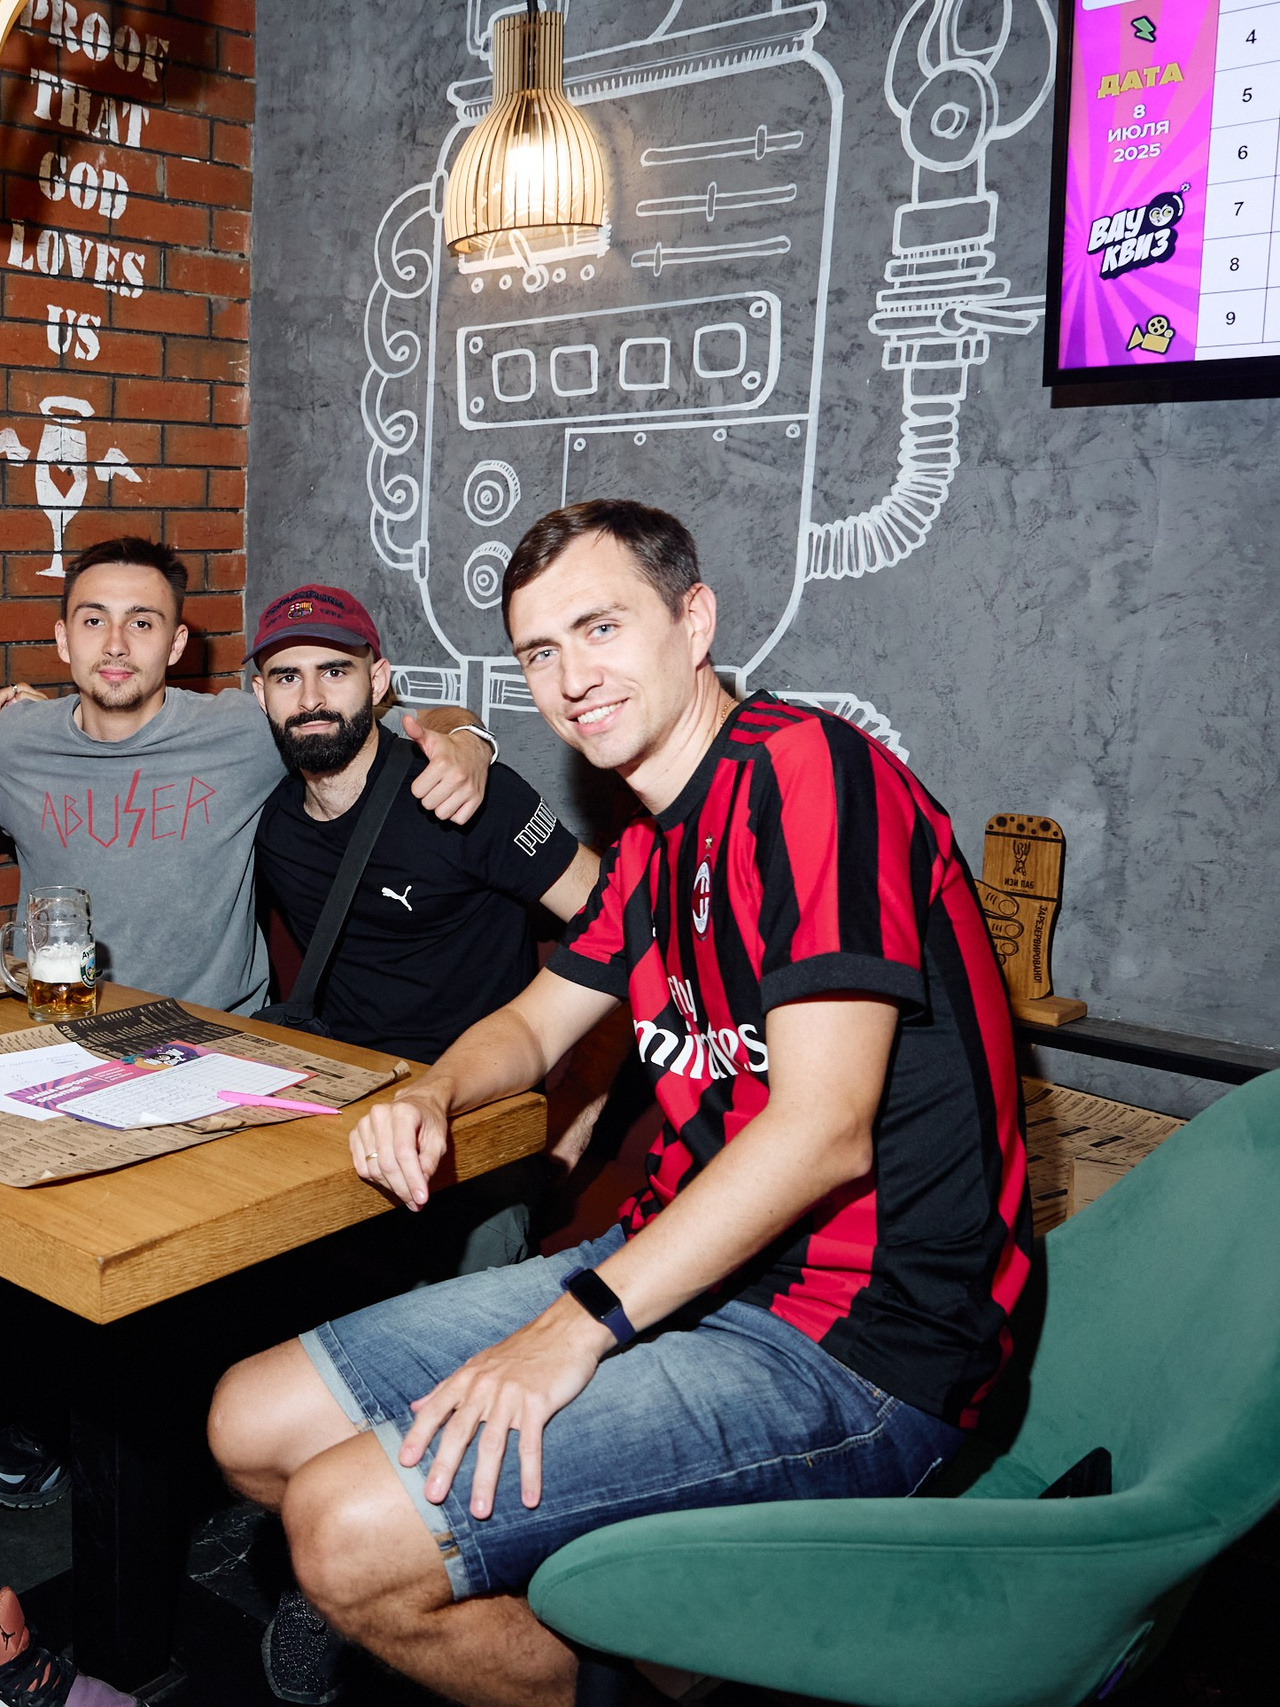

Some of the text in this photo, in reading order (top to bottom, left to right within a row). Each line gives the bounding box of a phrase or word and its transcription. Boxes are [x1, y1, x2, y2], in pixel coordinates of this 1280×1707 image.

[1245, 29, 1257, 44] 4
[1097, 62, 1184, 99] ДАТА
[1241, 87, 1253, 103] 5
[30, 68, 150, 148] THAT
[1133, 104, 1146, 119] 8
[1107, 120, 1169, 143] ИЮЛЯ
[1113, 143, 1161, 163] 2025
[1237, 145, 1248, 160] 6
[38, 151, 129, 220] GOD
[1234, 201, 1244, 216] 7
[1088, 205, 1147, 253] ВАУ
[7, 218, 146, 299] LOVES
[1100, 228, 1171, 274] КВИЗ
[1229, 257, 1240, 272] 8
[46, 304, 102, 362] US
[1225, 311, 1236, 326] 9
[40, 768, 217, 849] ABUSER
[514, 797, 557, 857] PUM
[1004, 877, 1035, 890] ИЗИ ПАБ
[667, 975, 697, 1022] Fly
